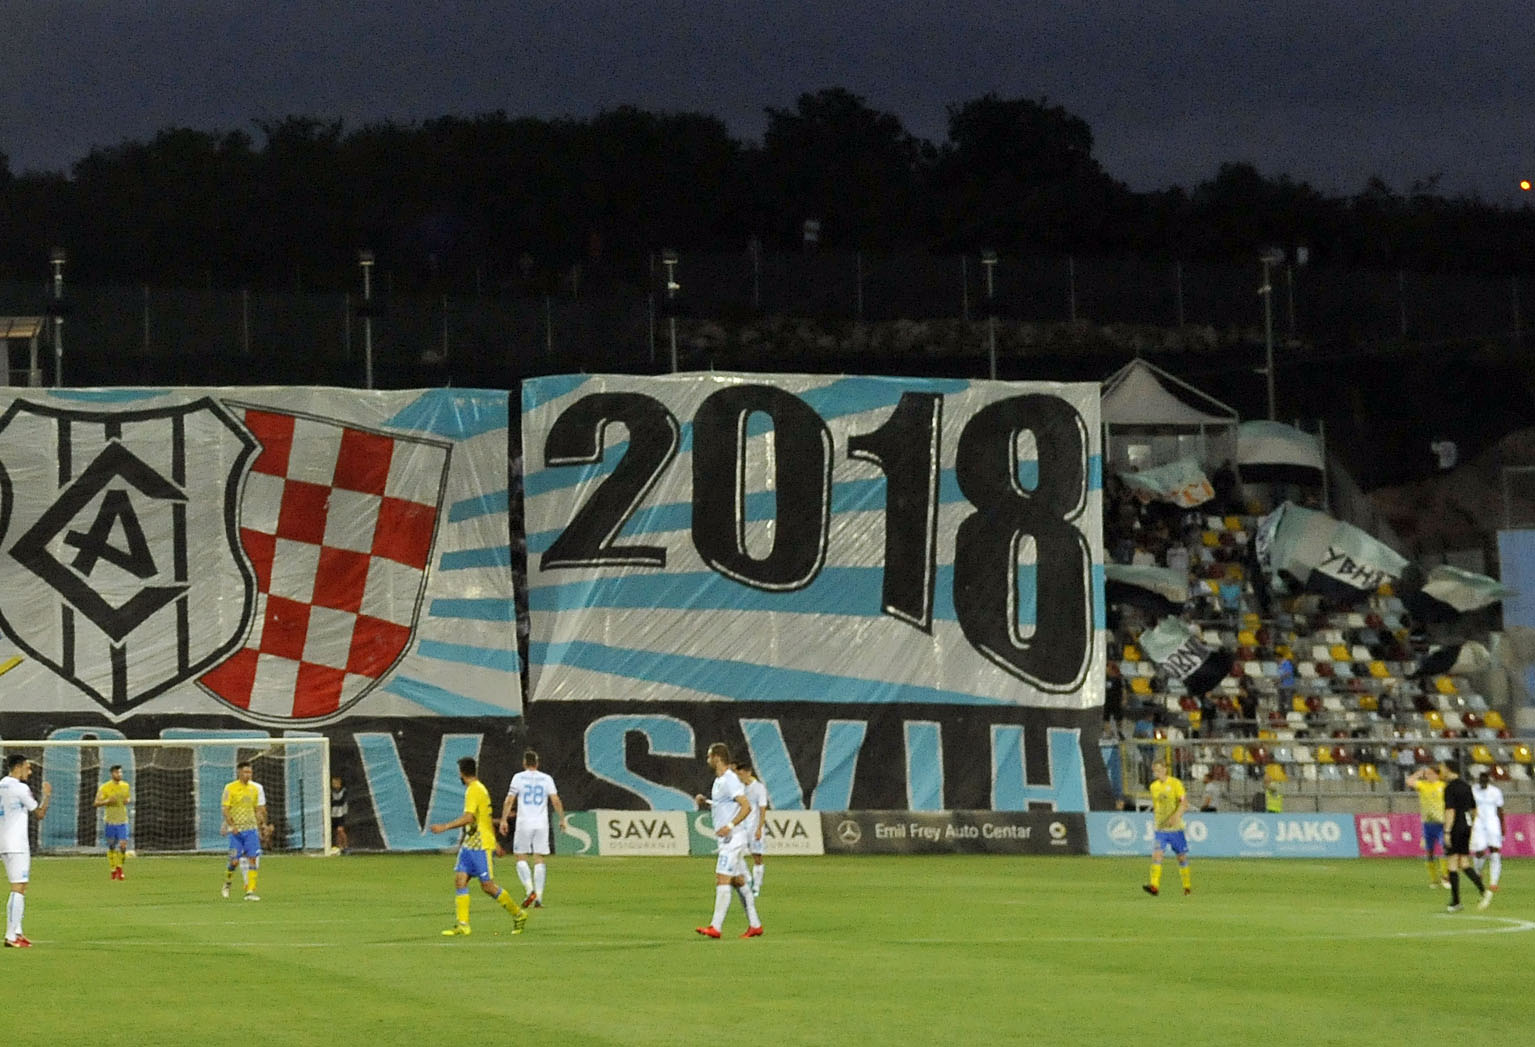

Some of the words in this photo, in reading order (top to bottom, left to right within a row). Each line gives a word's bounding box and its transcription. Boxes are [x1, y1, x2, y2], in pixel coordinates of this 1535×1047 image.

[538, 383, 1095, 695] 2018
[583, 713, 1090, 812] SVIH
[523, 784, 544, 806] 28
[608, 819, 675, 839] SAVA
[764, 819, 809, 839] AVA
[874, 823, 906, 839] Emil
[910, 823, 941, 842] Frey
[945, 823, 979, 839] Auto
[1143, 820, 1209, 842] JO
[1275, 820, 1342, 842] JAKO
